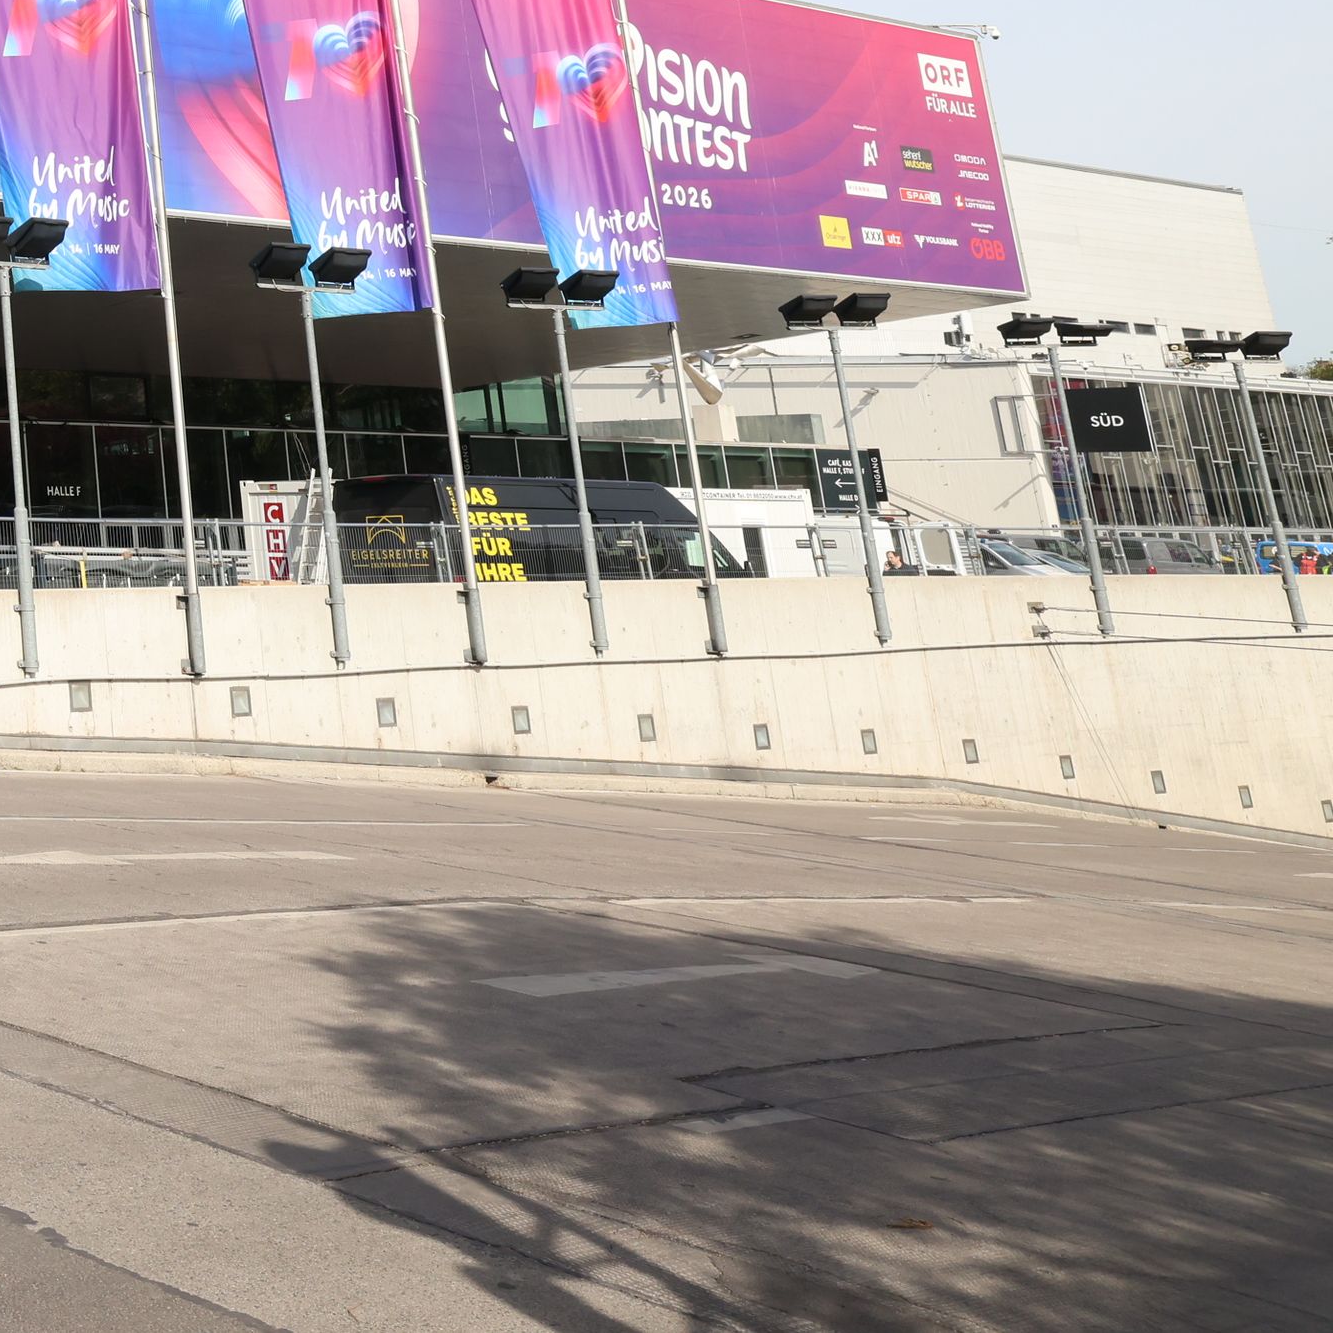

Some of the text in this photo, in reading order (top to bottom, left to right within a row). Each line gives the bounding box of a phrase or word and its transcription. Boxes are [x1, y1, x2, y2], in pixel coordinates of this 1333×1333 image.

[924, 62, 965, 88] ORF
[925, 93, 977, 118] FÜR ALLE
[33, 145, 115, 193] United
[66, 188, 130, 228] Music
[321, 177, 406, 225] United
[661, 184, 712, 209] 2026
[906, 191, 930, 203] SPAR
[575, 196, 658, 242] United
[94, 243, 103, 254] 16
[104, 244, 120, 255] MAY
[610, 236, 665, 273] Musi
[384, 269, 396, 278] 16
[633, 284, 646, 293] 16
[1090, 412, 1124, 428] SÜD
[871, 457, 883, 493] EINGANG
[46, 485, 81, 497] HALLE F
[472, 532, 513, 556] FÜR
[476, 563, 527, 582] IHRE
